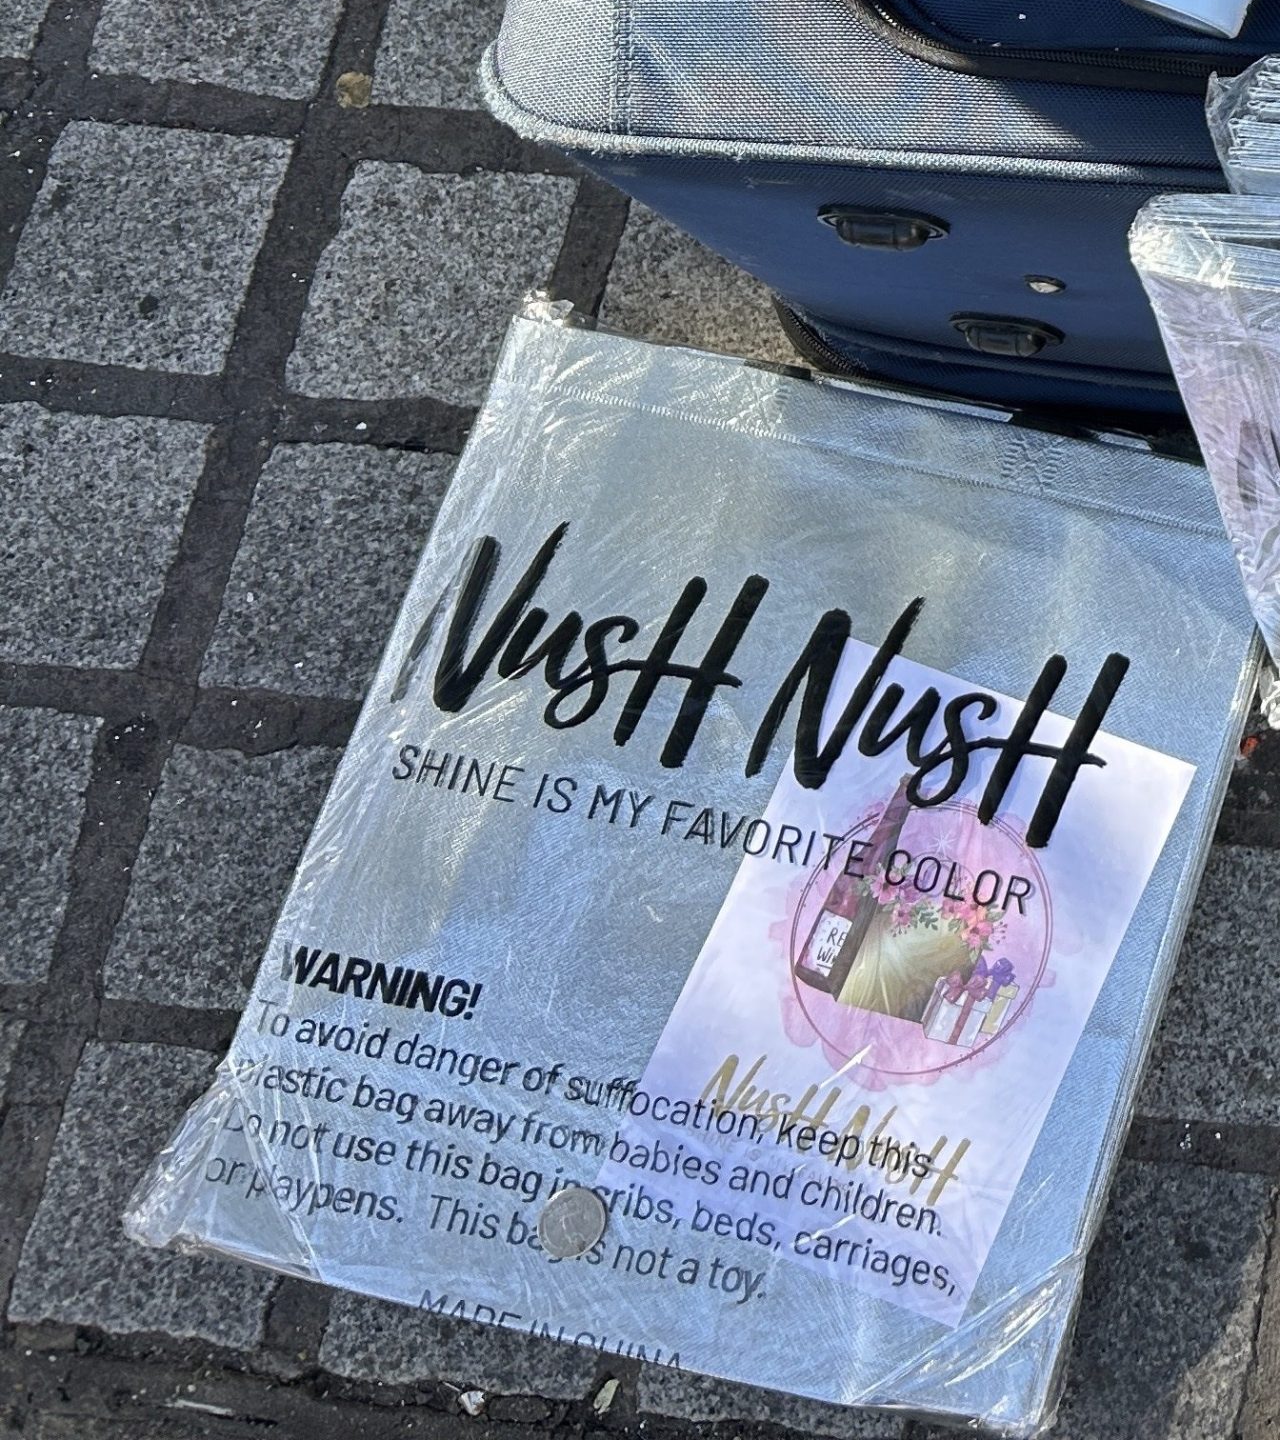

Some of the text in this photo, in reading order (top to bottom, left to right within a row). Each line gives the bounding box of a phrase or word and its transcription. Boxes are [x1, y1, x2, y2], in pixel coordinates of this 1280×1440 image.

[391, 521, 1130, 848] NusH NusH
[392, 744, 1032, 915] SHINE IS MY FAVORITE COLOR
[281, 945, 483, 1021] WARNING!
[256, 998, 290, 1037] To
[295, 1018, 391, 1060] avoid
[394, 1034, 521, 1087] danger
[522, 1062, 565, 1095] of
[564, 1071, 764, 1145] suffocation,
[776, 1112, 861, 1169] keep
[868, 1136, 933, 1179] this
[352, 1074, 419, 1125] bag
[424, 1098, 517, 1145] away
[520, 1111, 604, 1158] from
[608, 1132, 720, 1186] babies
[728, 1164, 795, 1201] and
[801, 1176, 943, 1238] children.
[203, 1156, 767, 1305] or playpens. This not a toy.
[268, 1119, 331, 1153] not
[332, 1131, 397, 1167] use
[404, 1138, 475, 1181] this
[477, 1152, 543, 1203] bag
[690, 1200, 781, 1250] beds,
[793, 1230, 957, 1296] carriages,
